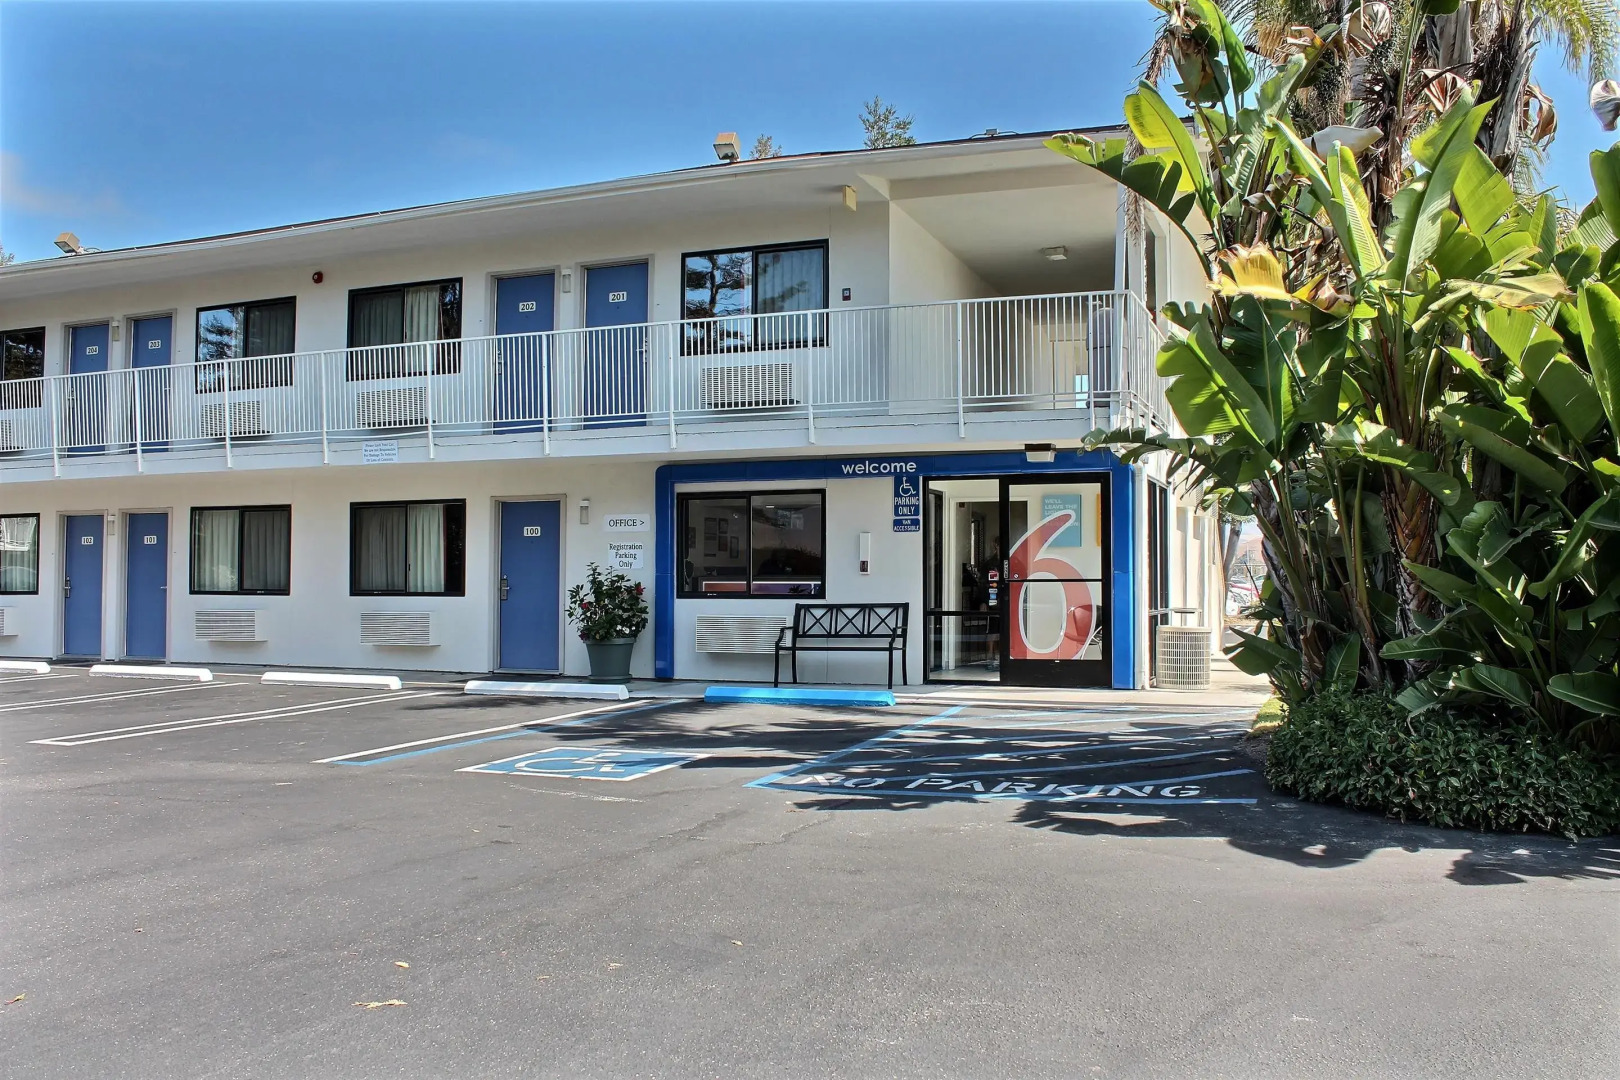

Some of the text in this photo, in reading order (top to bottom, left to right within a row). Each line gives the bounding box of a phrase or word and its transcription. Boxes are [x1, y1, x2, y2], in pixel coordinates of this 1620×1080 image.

[611, 293, 625, 301] 201
[842, 460, 916, 474] welcome
[894, 496, 919, 505] PARKING
[898, 506, 915, 514] ONLY
[608, 519, 637, 527] OFFICE
[609, 543, 642, 551] Registration
[615, 552, 637, 560] Parking
[618, 560, 633, 569] Only
[794, 774, 1200, 797] NO PARKING
